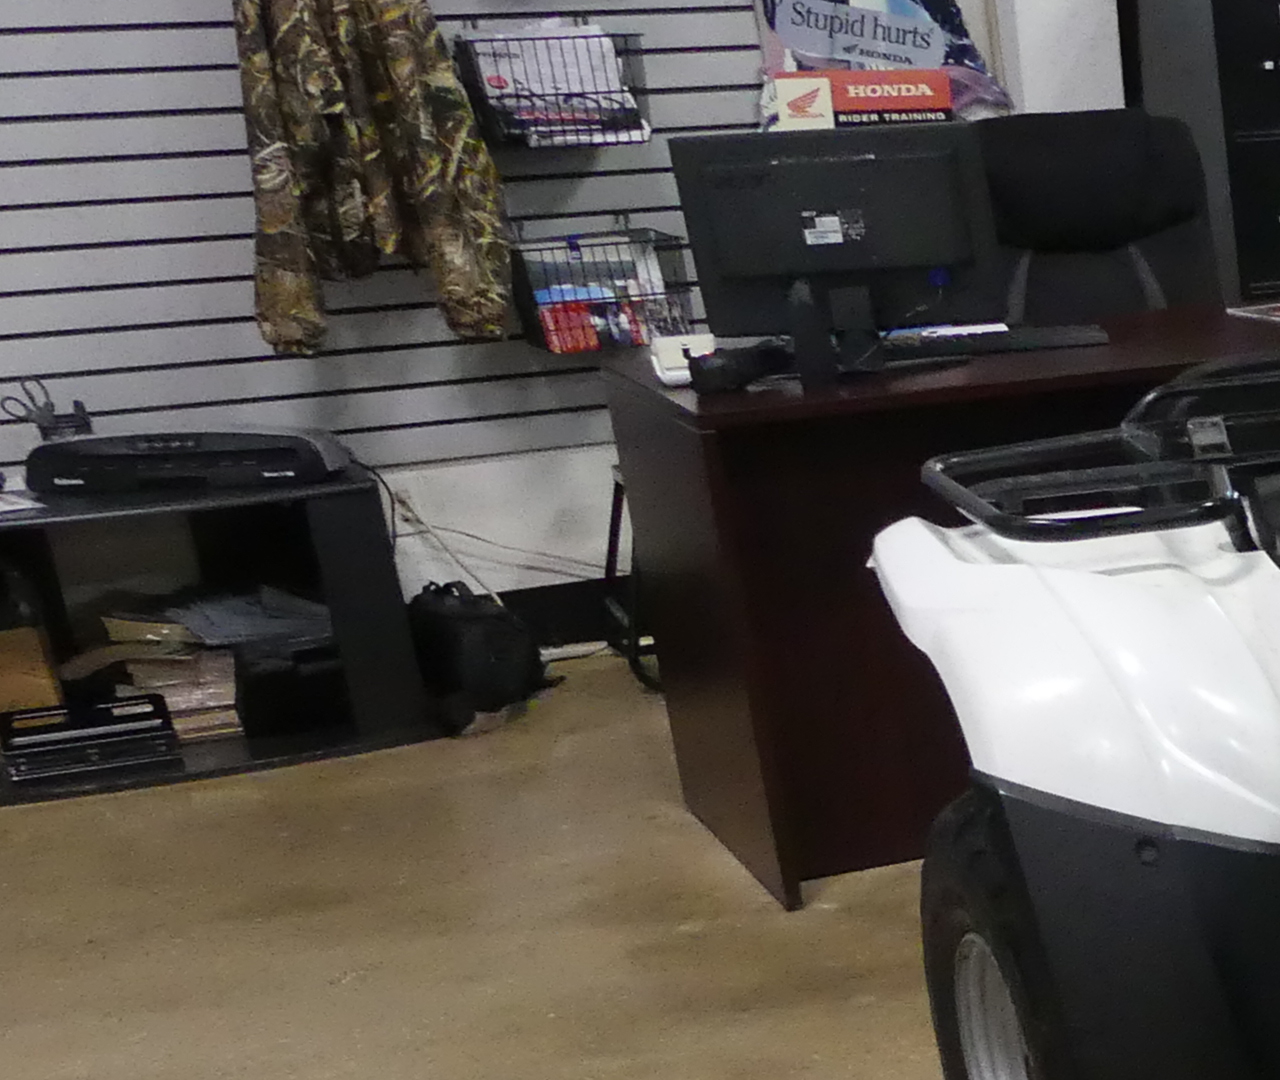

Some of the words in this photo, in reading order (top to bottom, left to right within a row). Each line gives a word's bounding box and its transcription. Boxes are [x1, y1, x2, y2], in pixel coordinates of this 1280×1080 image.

[791, 1, 866, 39] Stupid
[858, 48, 913, 65] HONDA
[847, 83, 935, 97] HONDA
[838, 113, 879, 123] RIDER
[884, 111, 947, 122] TRAINING
